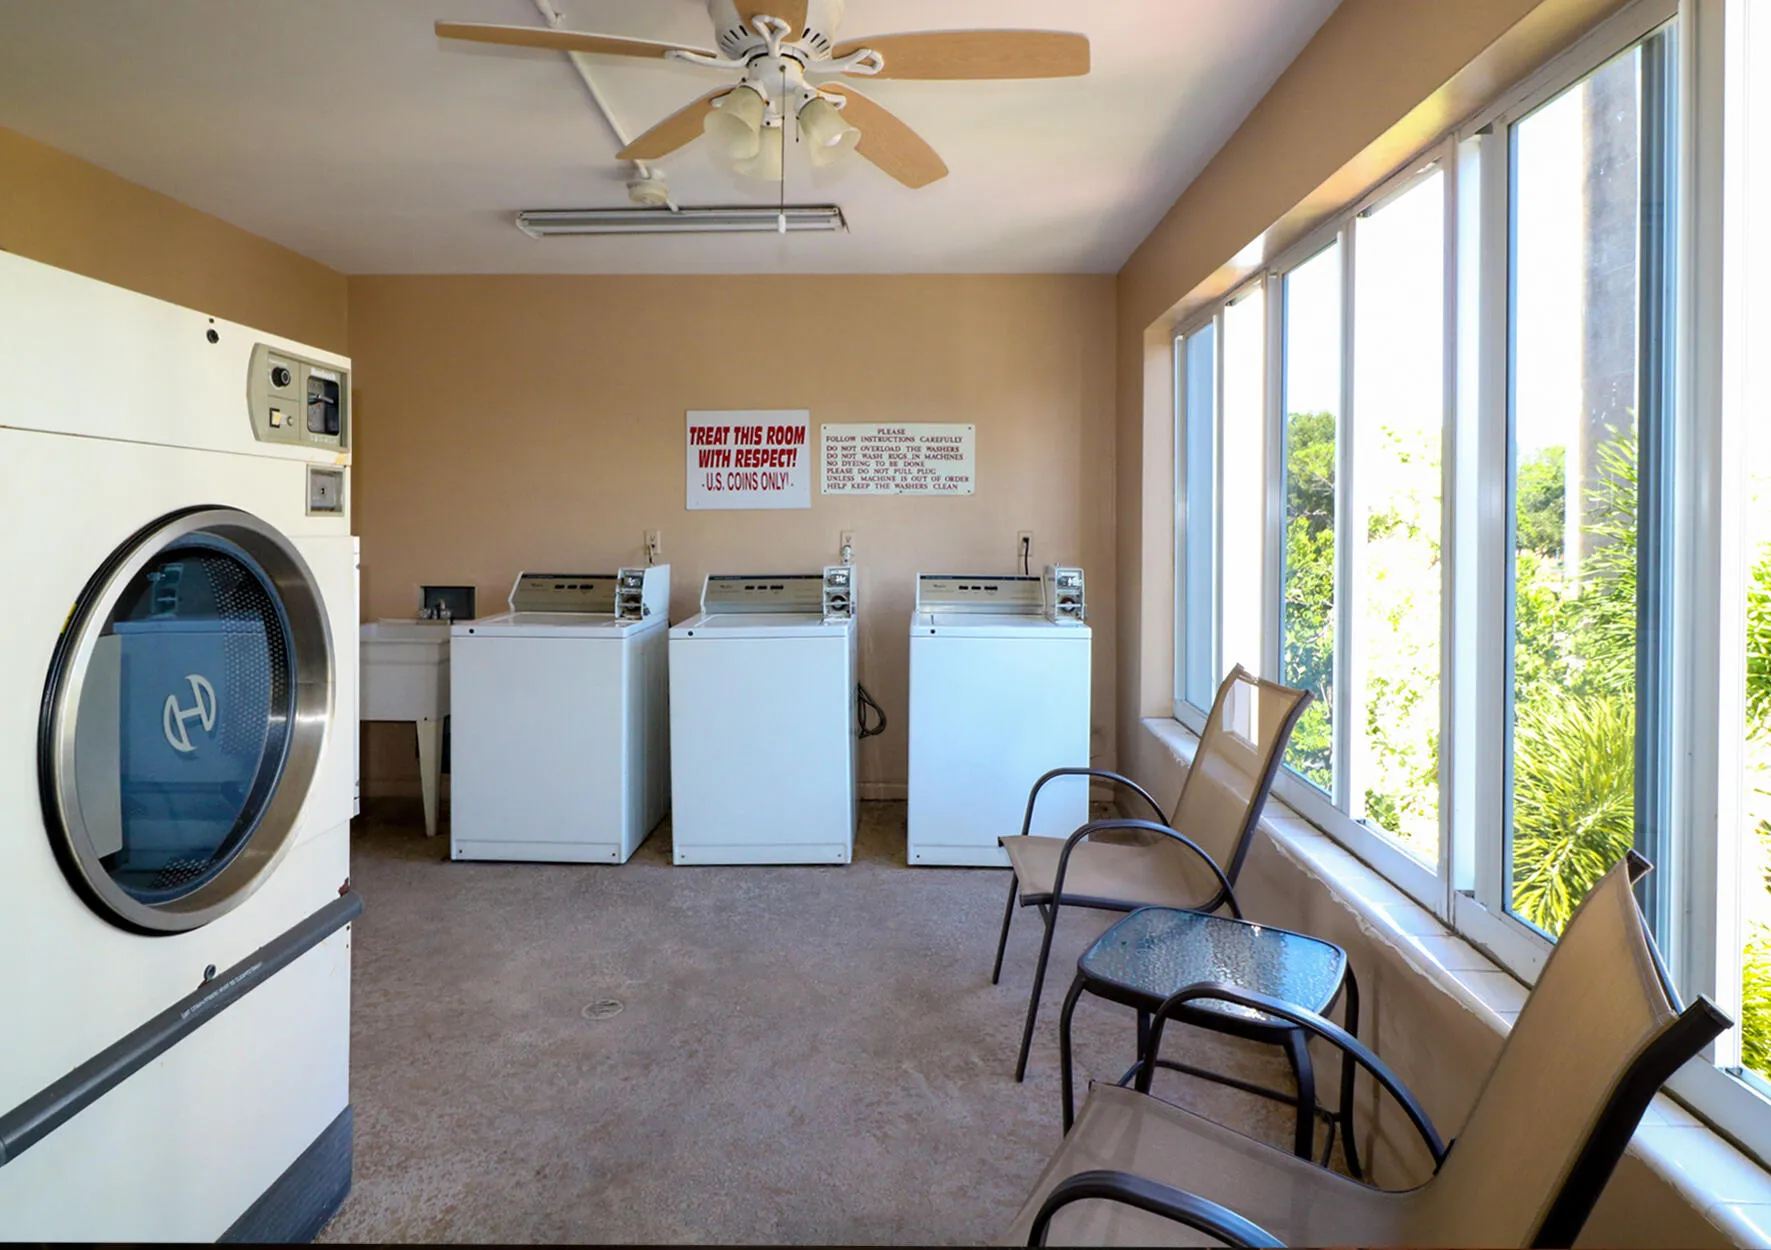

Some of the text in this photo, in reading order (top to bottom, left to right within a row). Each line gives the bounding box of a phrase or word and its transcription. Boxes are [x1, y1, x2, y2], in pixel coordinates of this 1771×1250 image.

[689, 426, 806, 445] TREAT THIS ROOM
[698, 448, 797, 468] WITH RESPECT!
[706, 472, 789, 491] U.S. COINS ONLY!
